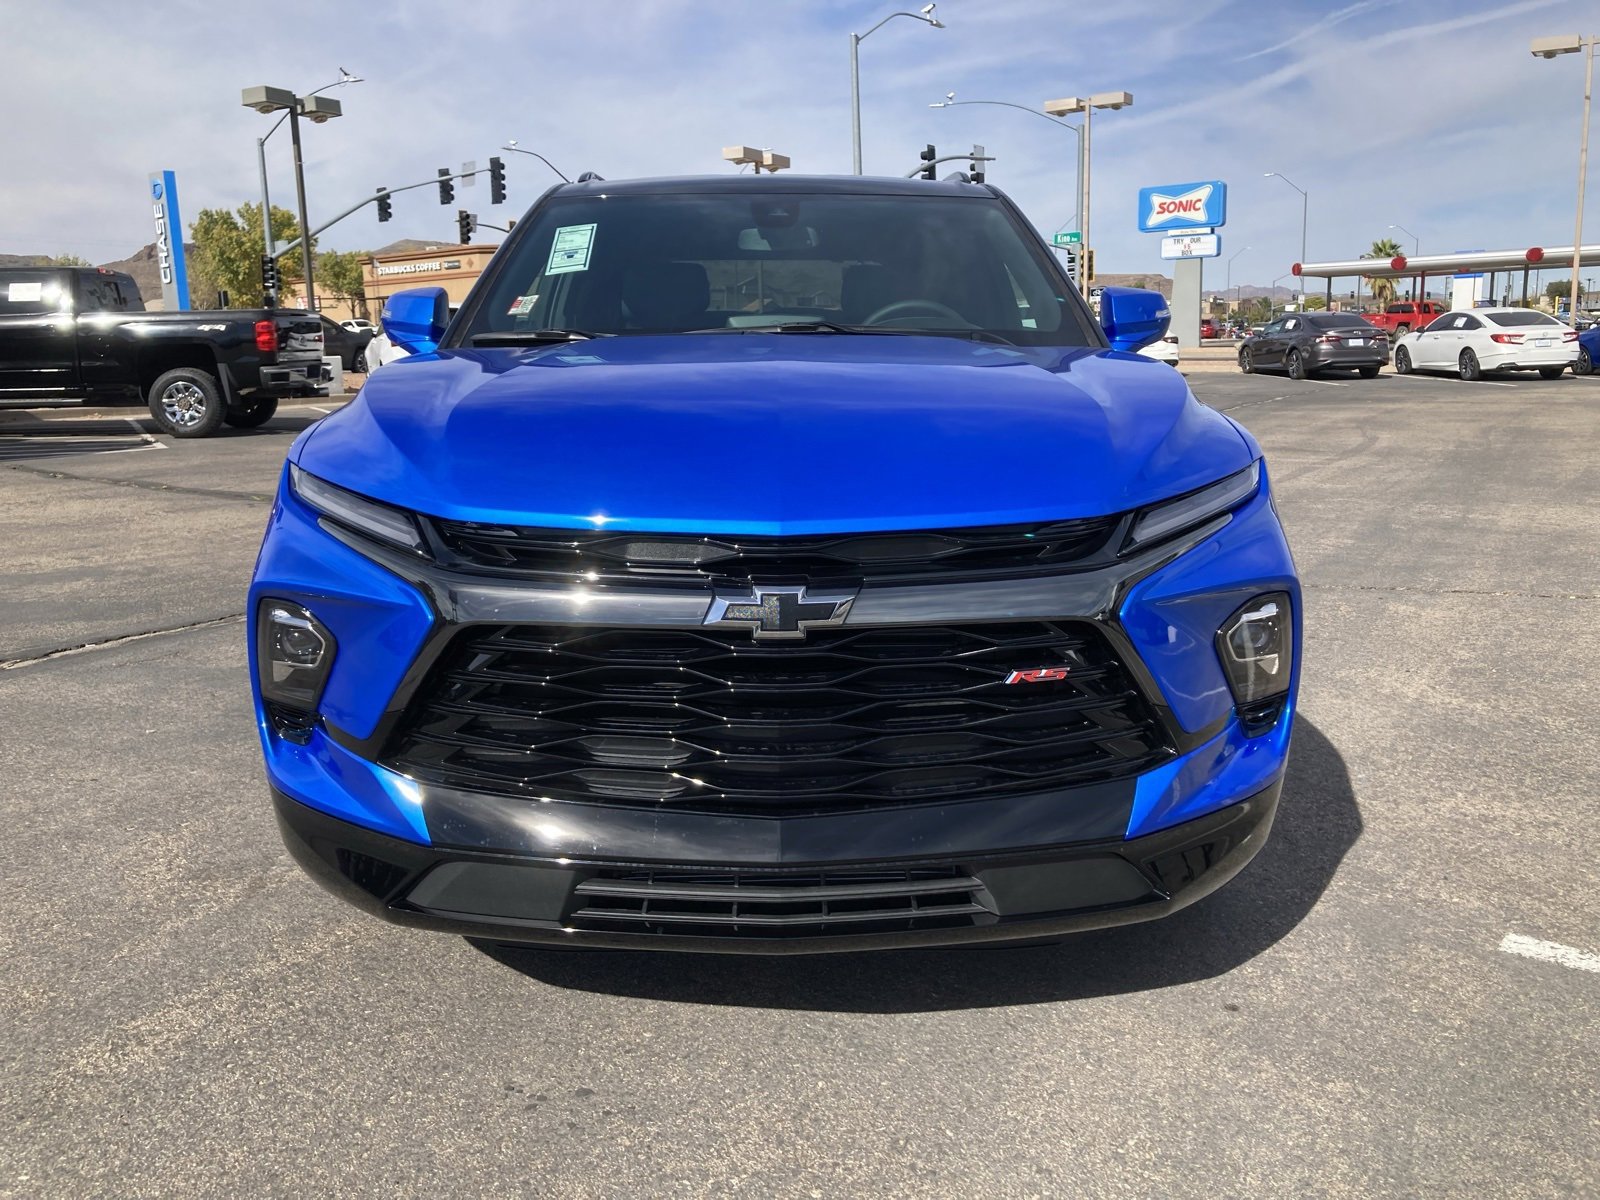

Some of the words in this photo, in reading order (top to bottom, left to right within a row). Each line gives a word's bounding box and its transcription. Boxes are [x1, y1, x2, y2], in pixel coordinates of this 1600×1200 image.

[1156, 199, 1202, 215] SONIC
[153, 203, 171, 284] CHASE
[377, 263, 416, 276] STARBUCKS
[415, 261, 441, 272] COFFEE
[1004, 667, 1070, 684] RS
